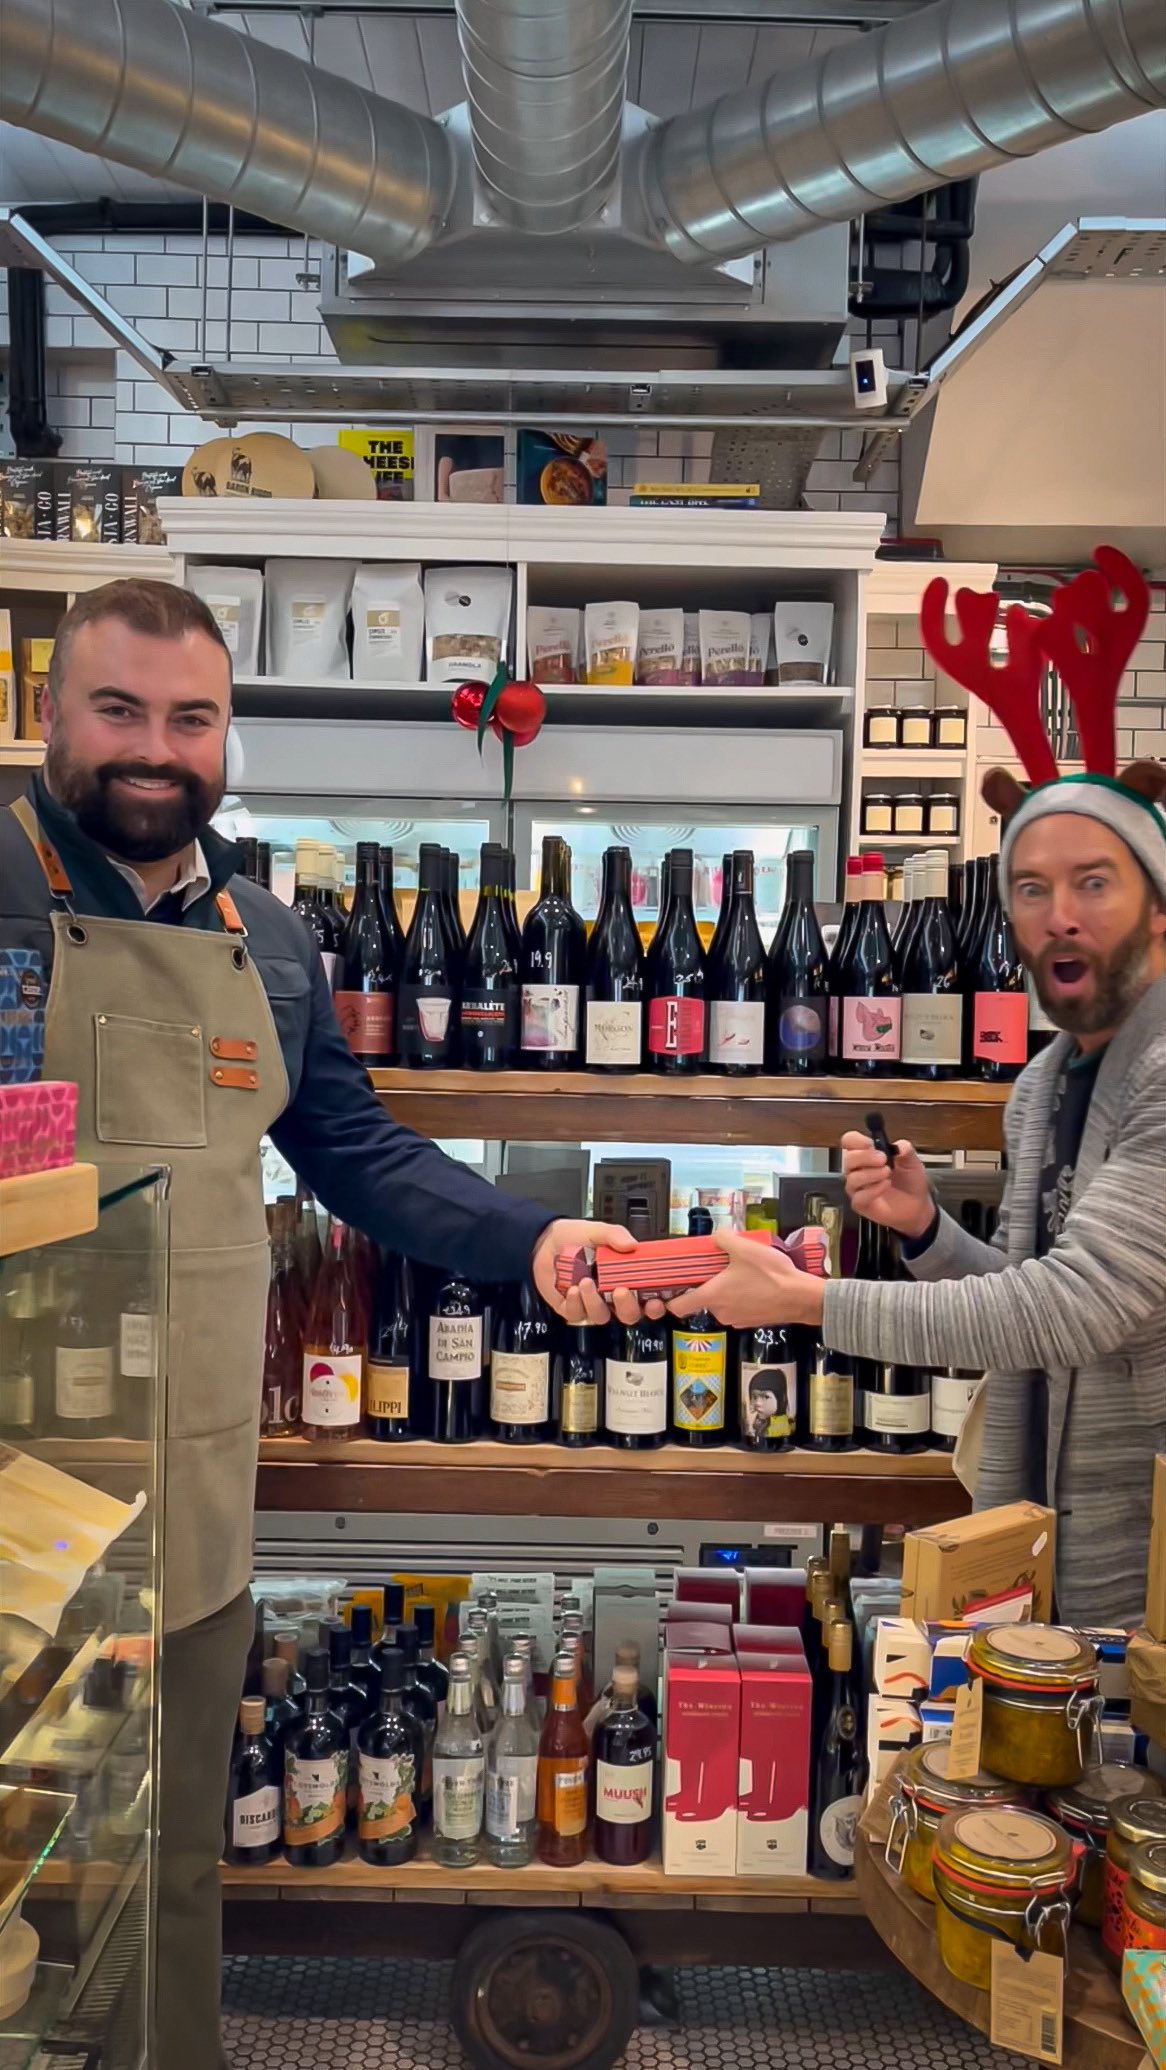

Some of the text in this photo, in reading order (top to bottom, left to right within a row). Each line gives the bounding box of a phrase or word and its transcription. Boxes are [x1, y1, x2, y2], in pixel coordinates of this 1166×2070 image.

[368, 440, 403, 454] THE
[124, 494, 139, 544] RNWALL
[707, 643, 745, 657] Perello
[451, 1337, 473, 1349] SAN
